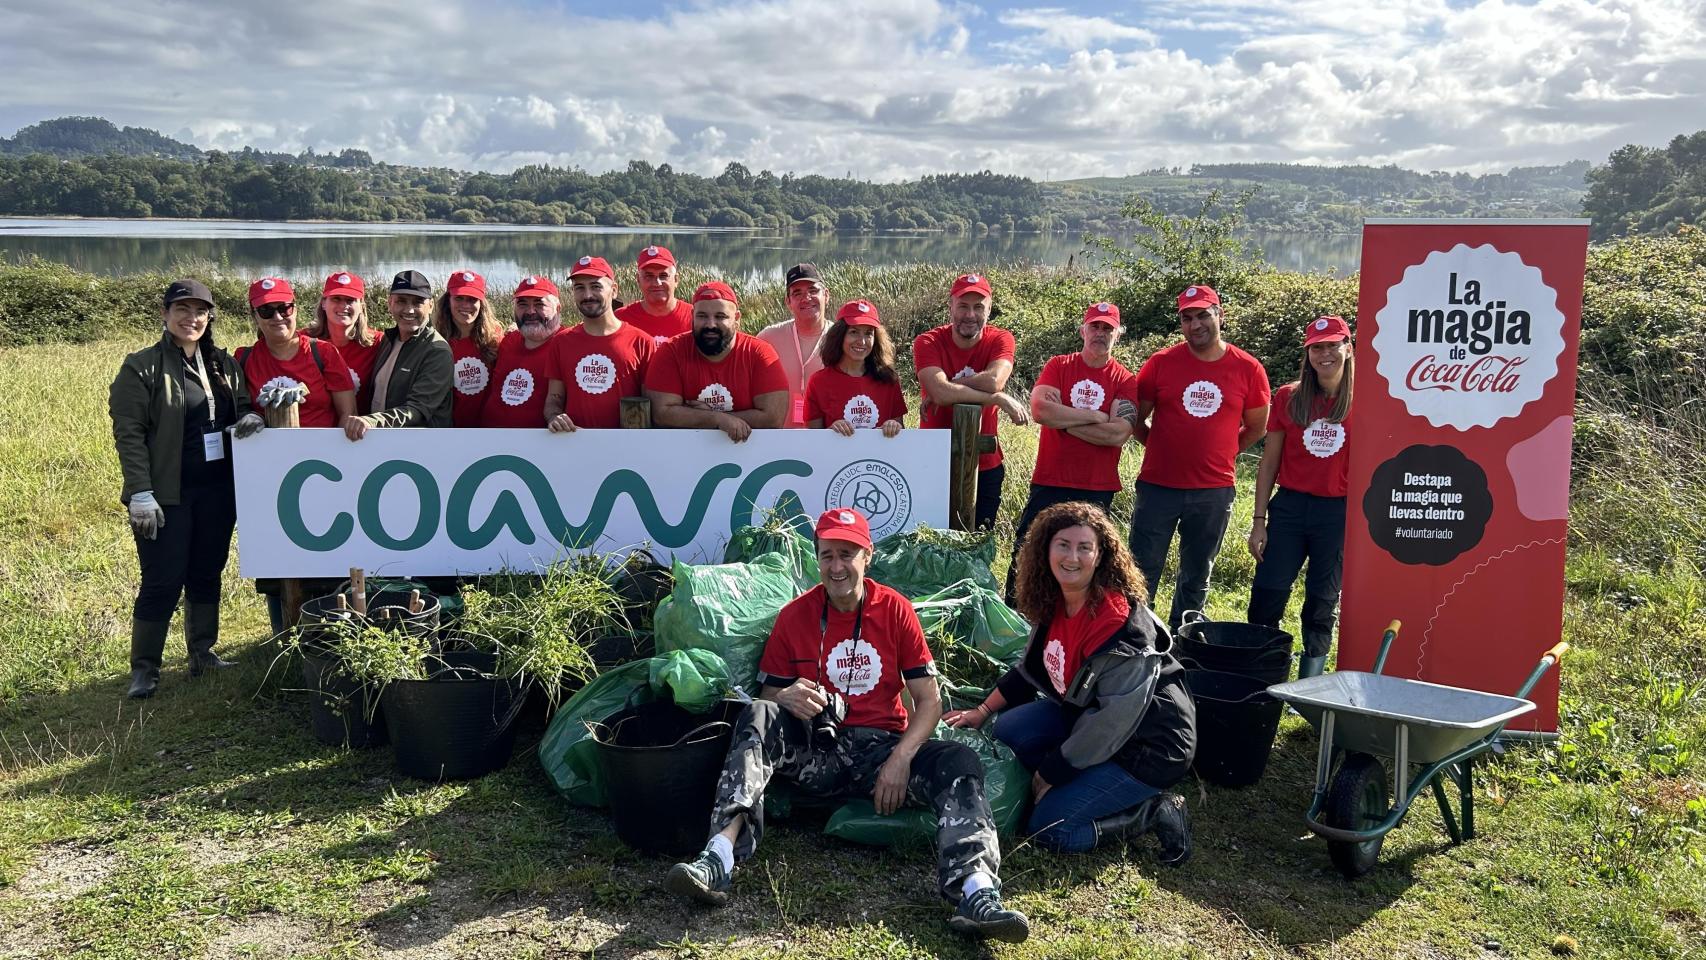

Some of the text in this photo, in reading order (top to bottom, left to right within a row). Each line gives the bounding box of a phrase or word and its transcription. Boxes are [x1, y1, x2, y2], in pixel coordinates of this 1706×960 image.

[1448, 272, 1481, 305] La
[1407, 301, 1531, 355] magia
[1449, 346, 1466, 360] de
[458, 366, 481, 378] magia
[582, 365, 608, 376] magia
[1405, 354, 1530, 393] Coca-Cola
[508, 379, 528, 390] magia
[1190, 391, 1215, 401] magia
[1321, 422, 1328, 430] La
[1311, 429, 1337, 440] magia
[844, 465, 862, 479] UDC
[1404, 472, 1452, 489] Destapa
[1391, 488, 1463, 506] la magia que
[1389, 505, 1465, 521] llevas dentro
[874, 526, 893, 540] UDC
[1395, 527, 1453, 539] #voluntariado
[845, 646, 855, 657] La
[836, 653, 872, 670] magia
